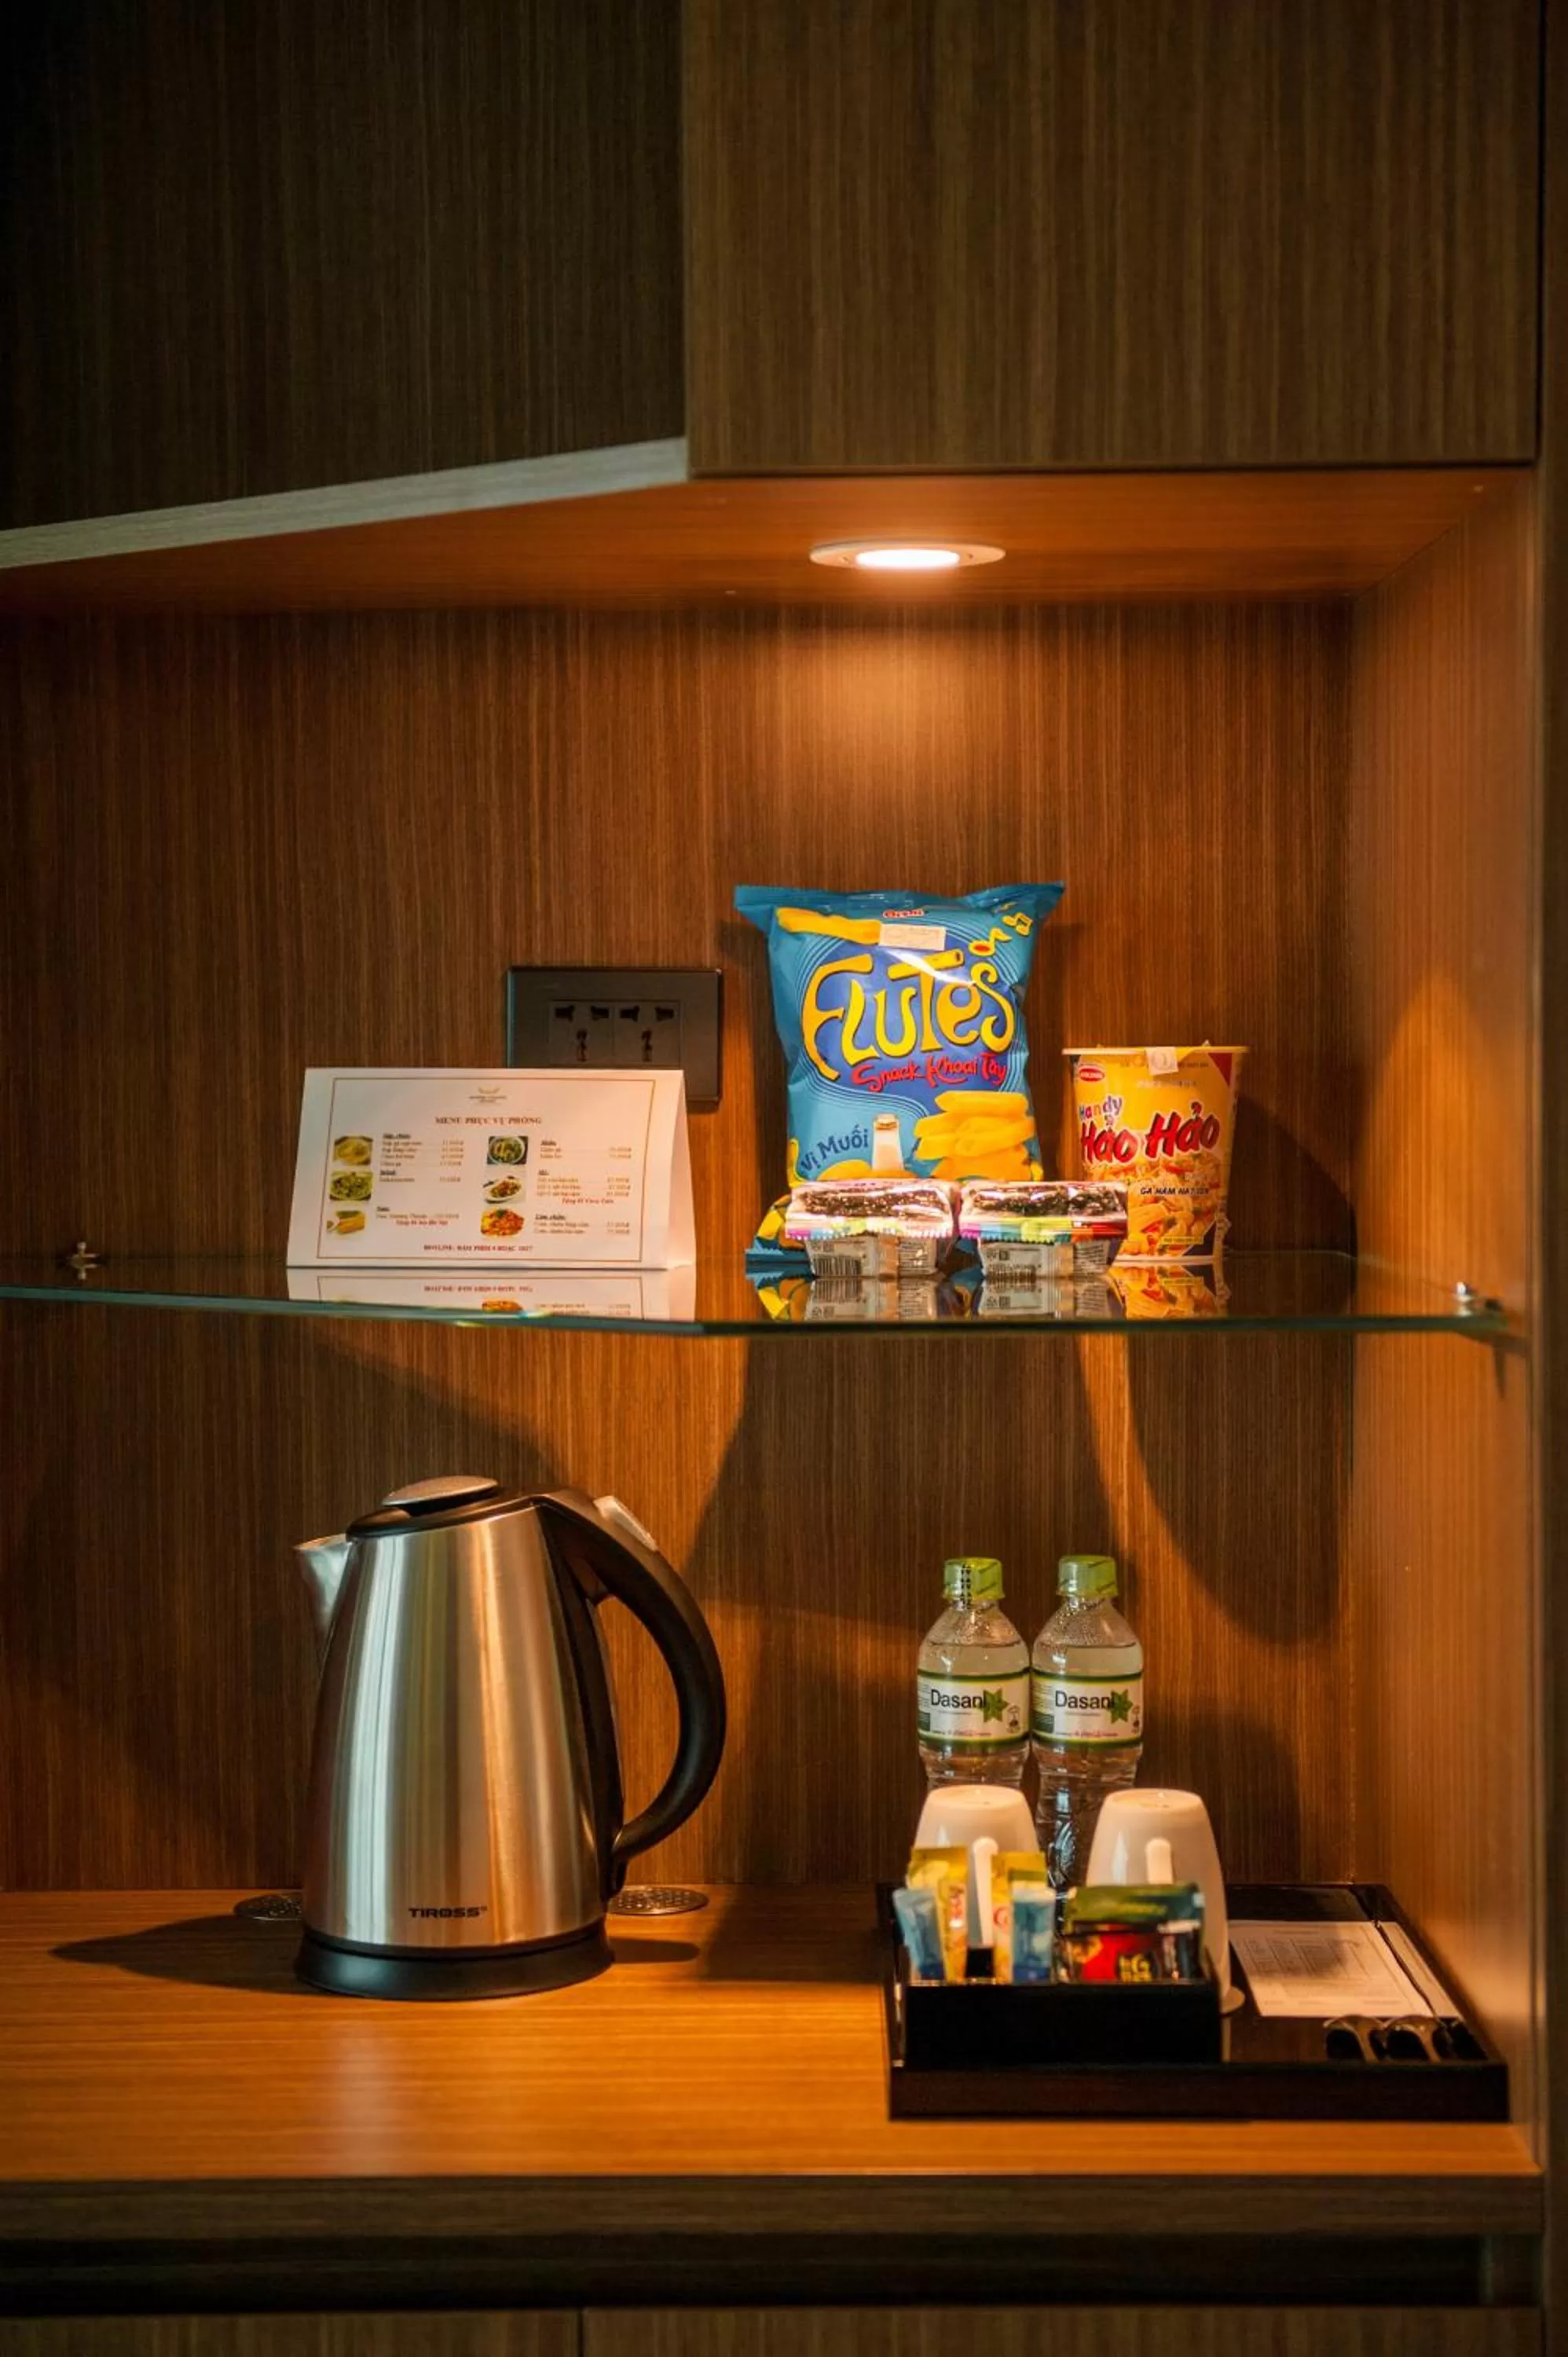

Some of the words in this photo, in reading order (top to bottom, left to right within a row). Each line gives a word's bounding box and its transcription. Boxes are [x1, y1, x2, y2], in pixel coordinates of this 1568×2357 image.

[851, 1063, 924, 1093] Snack
[925, 1055, 978, 1088] Khoai
[817, 1124, 869, 1160] Muối
[1145, 1102, 1220, 1159] Hảo
